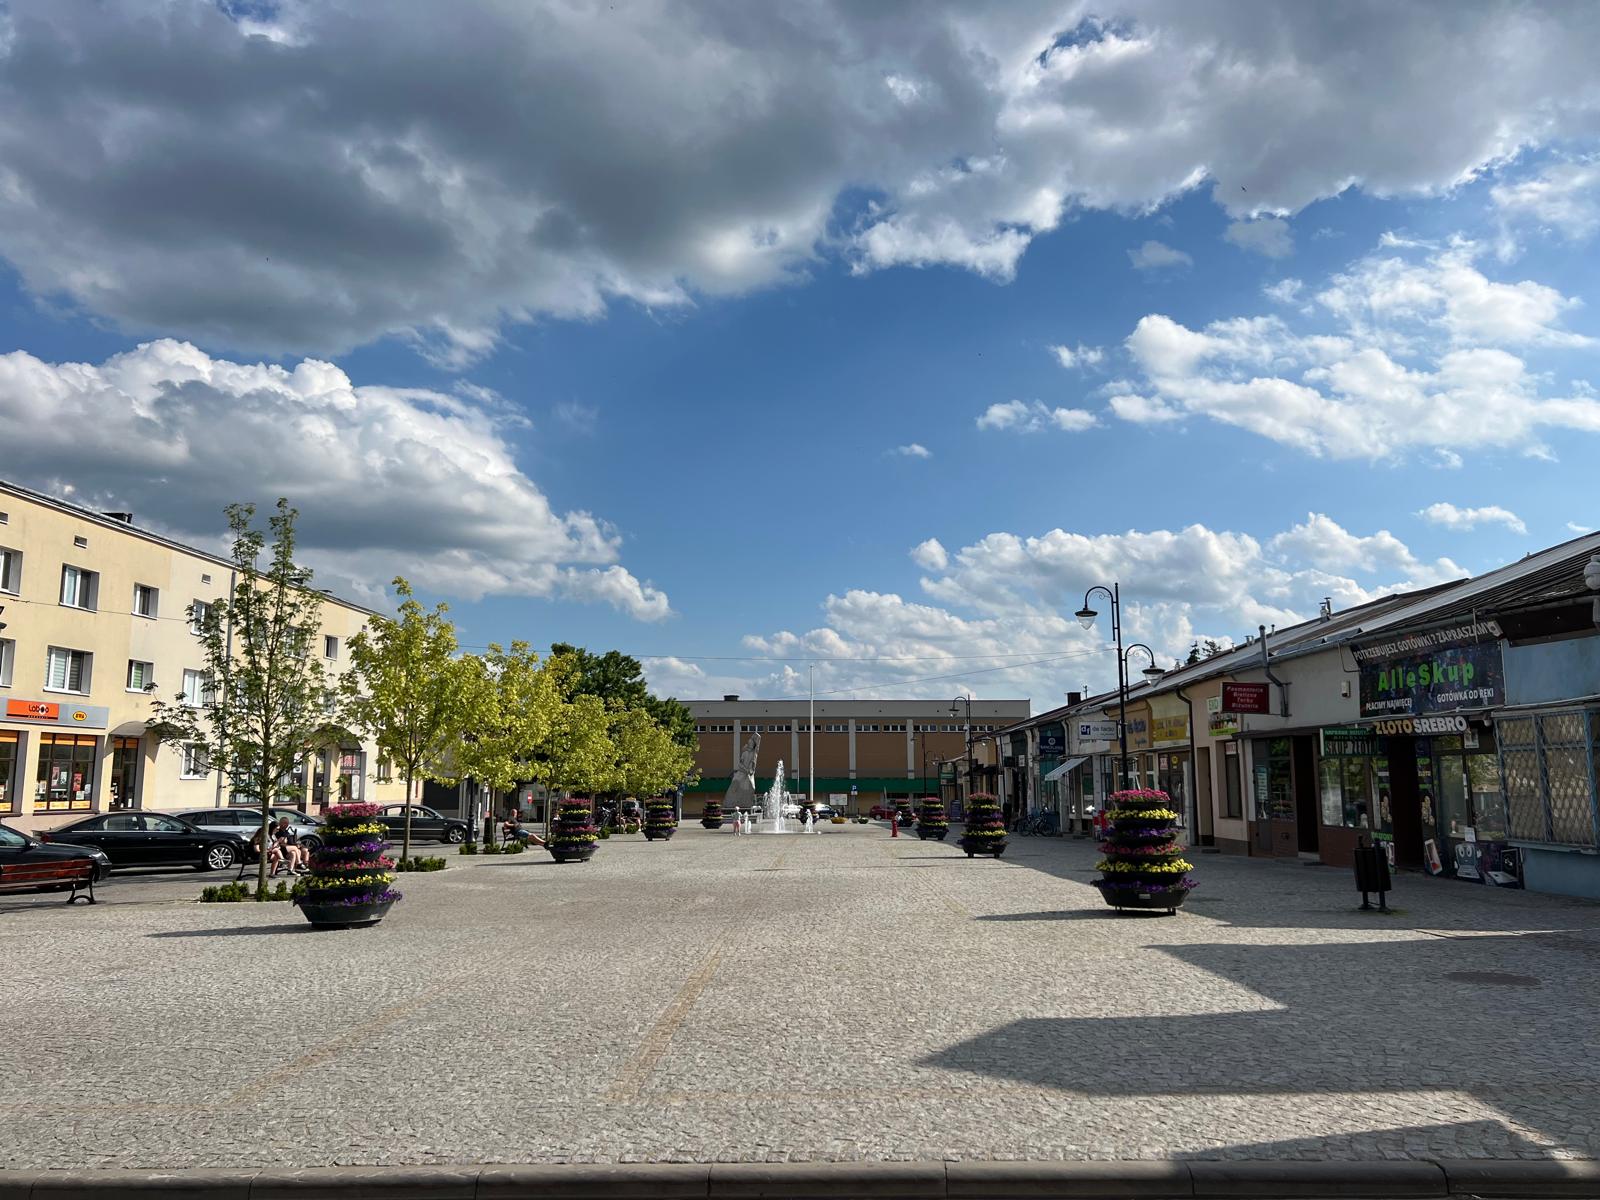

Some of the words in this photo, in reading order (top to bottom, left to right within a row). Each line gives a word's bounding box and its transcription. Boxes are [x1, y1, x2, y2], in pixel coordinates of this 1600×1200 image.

[1354, 642, 1399, 661] POTRZEBUJESZ
[1397, 635, 1432, 651] GOTÓWKI
[1436, 622, 1492, 643] ZAPRASZAMY
[1378, 661, 1474, 692] AlleSkup
[1437, 691, 1468, 703] GOTÓWKA
[1468, 691, 1478, 699] OD
[1373, 720, 1413, 735] ZŁOTO
[1412, 716, 1467, 733] SREBRO
